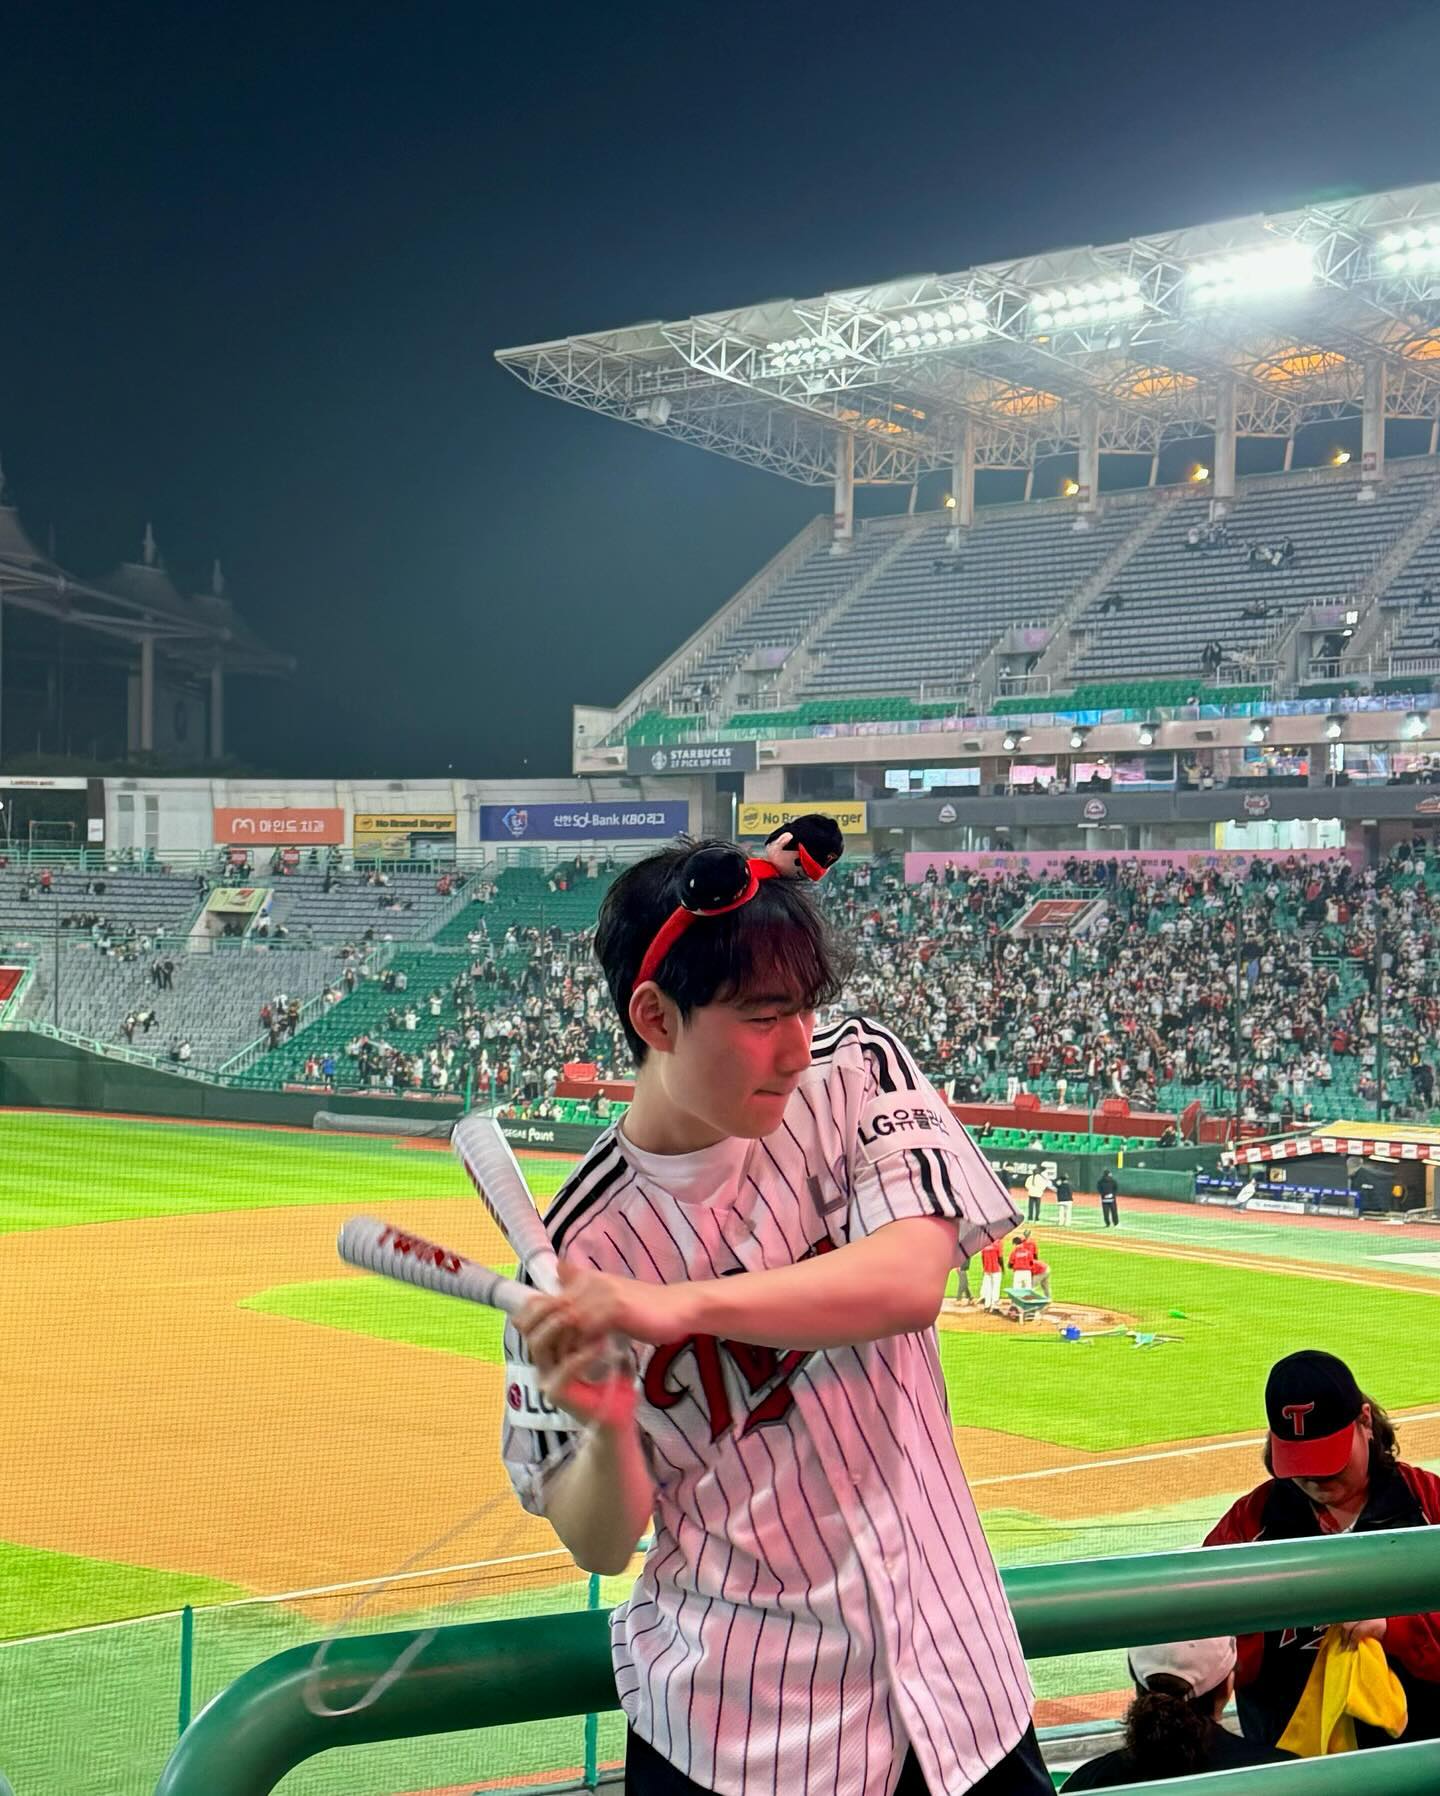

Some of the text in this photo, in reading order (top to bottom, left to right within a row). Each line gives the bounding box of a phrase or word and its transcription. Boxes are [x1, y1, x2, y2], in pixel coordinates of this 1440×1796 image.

[670, 748, 731, 760] STARBUCKS
[375, 819, 452, 830] No Brand Burger
[592, 813, 620, 826] Bank
[621, 813, 645, 825] KBO
[763, 812, 780, 825] No
[259, 819, 325, 834] 마인드 치과
[528, 1127, 555, 1142] Point
[1282, 1400, 1315, 1436] T
